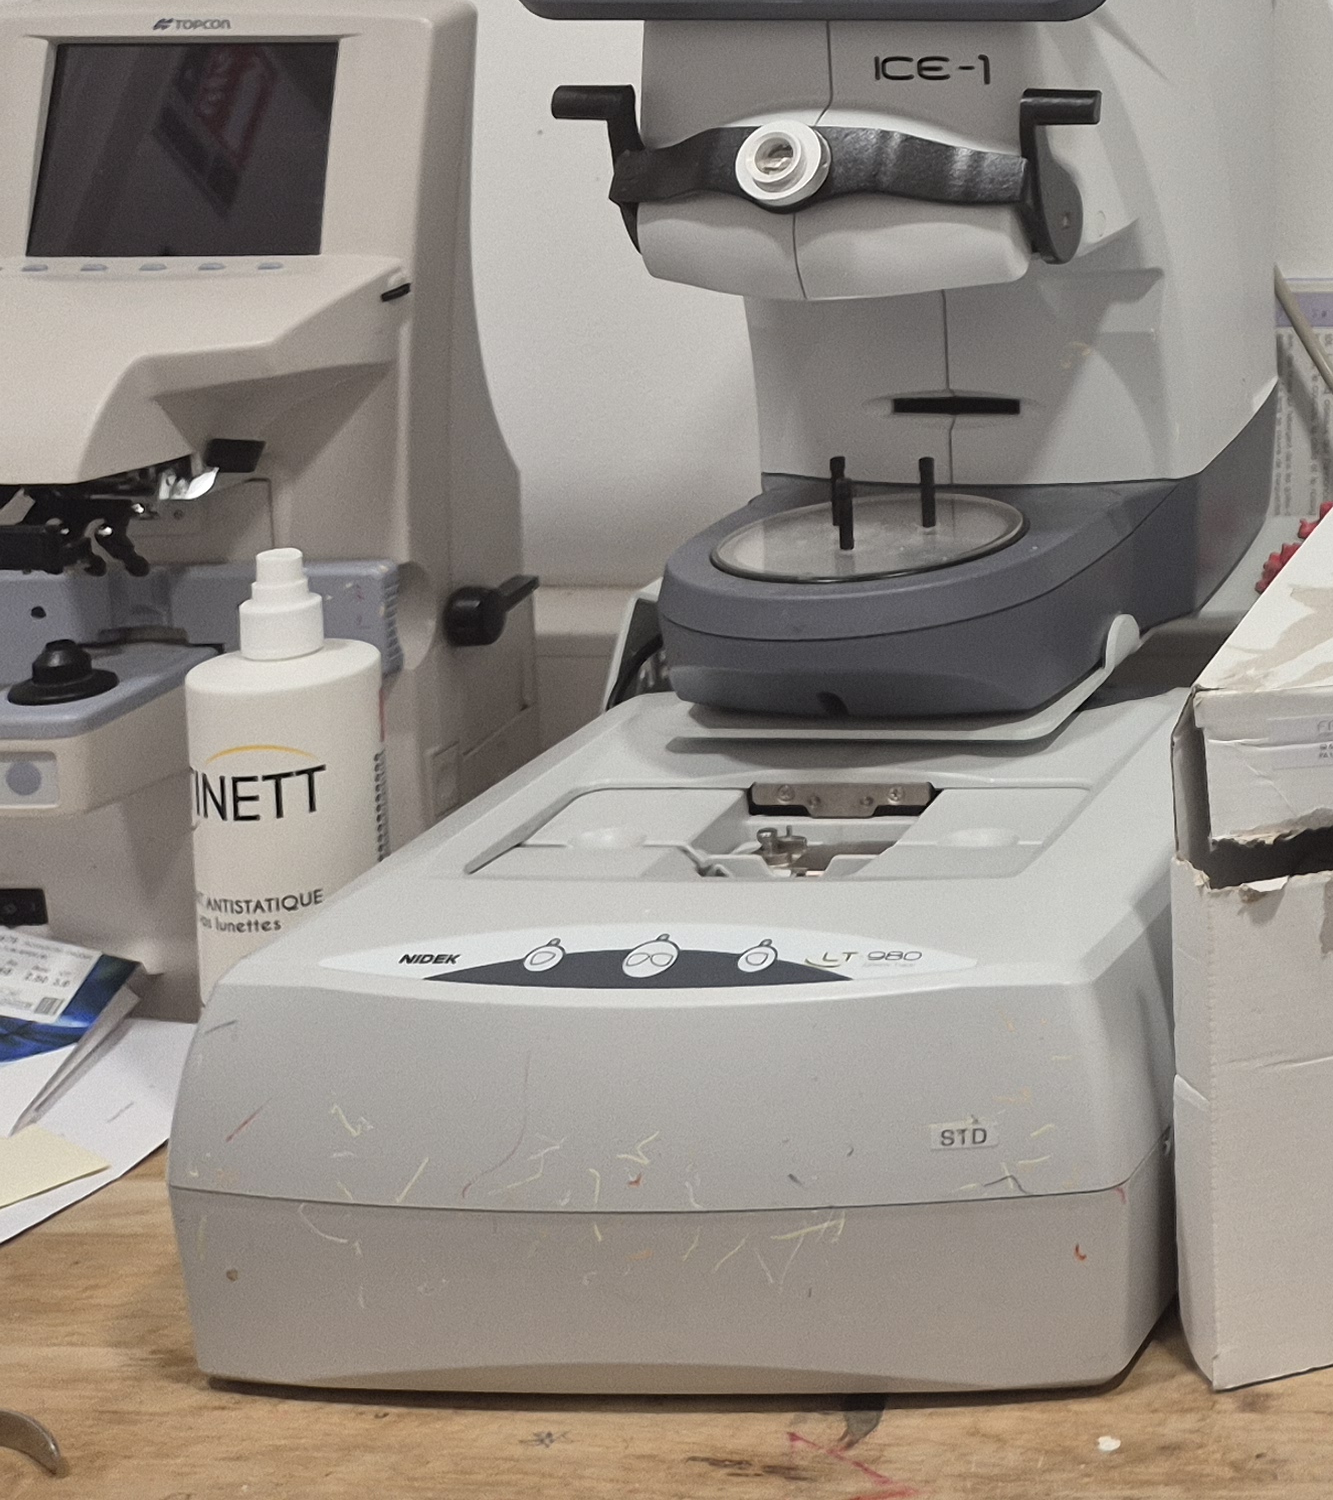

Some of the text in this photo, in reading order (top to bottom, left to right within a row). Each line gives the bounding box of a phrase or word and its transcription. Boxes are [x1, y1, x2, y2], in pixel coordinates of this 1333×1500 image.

[873, 54, 991, 85] ICE-1
[190, 764, 327, 822] INETT
[206, 888, 324, 916] ANTISTATIQUE
[215, 917, 283, 933] lunettes
[398, 953, 462, 965] NIDEK
[822, 950, 923, 963] LT 980
[940, 1127, 988, 1147] STD
